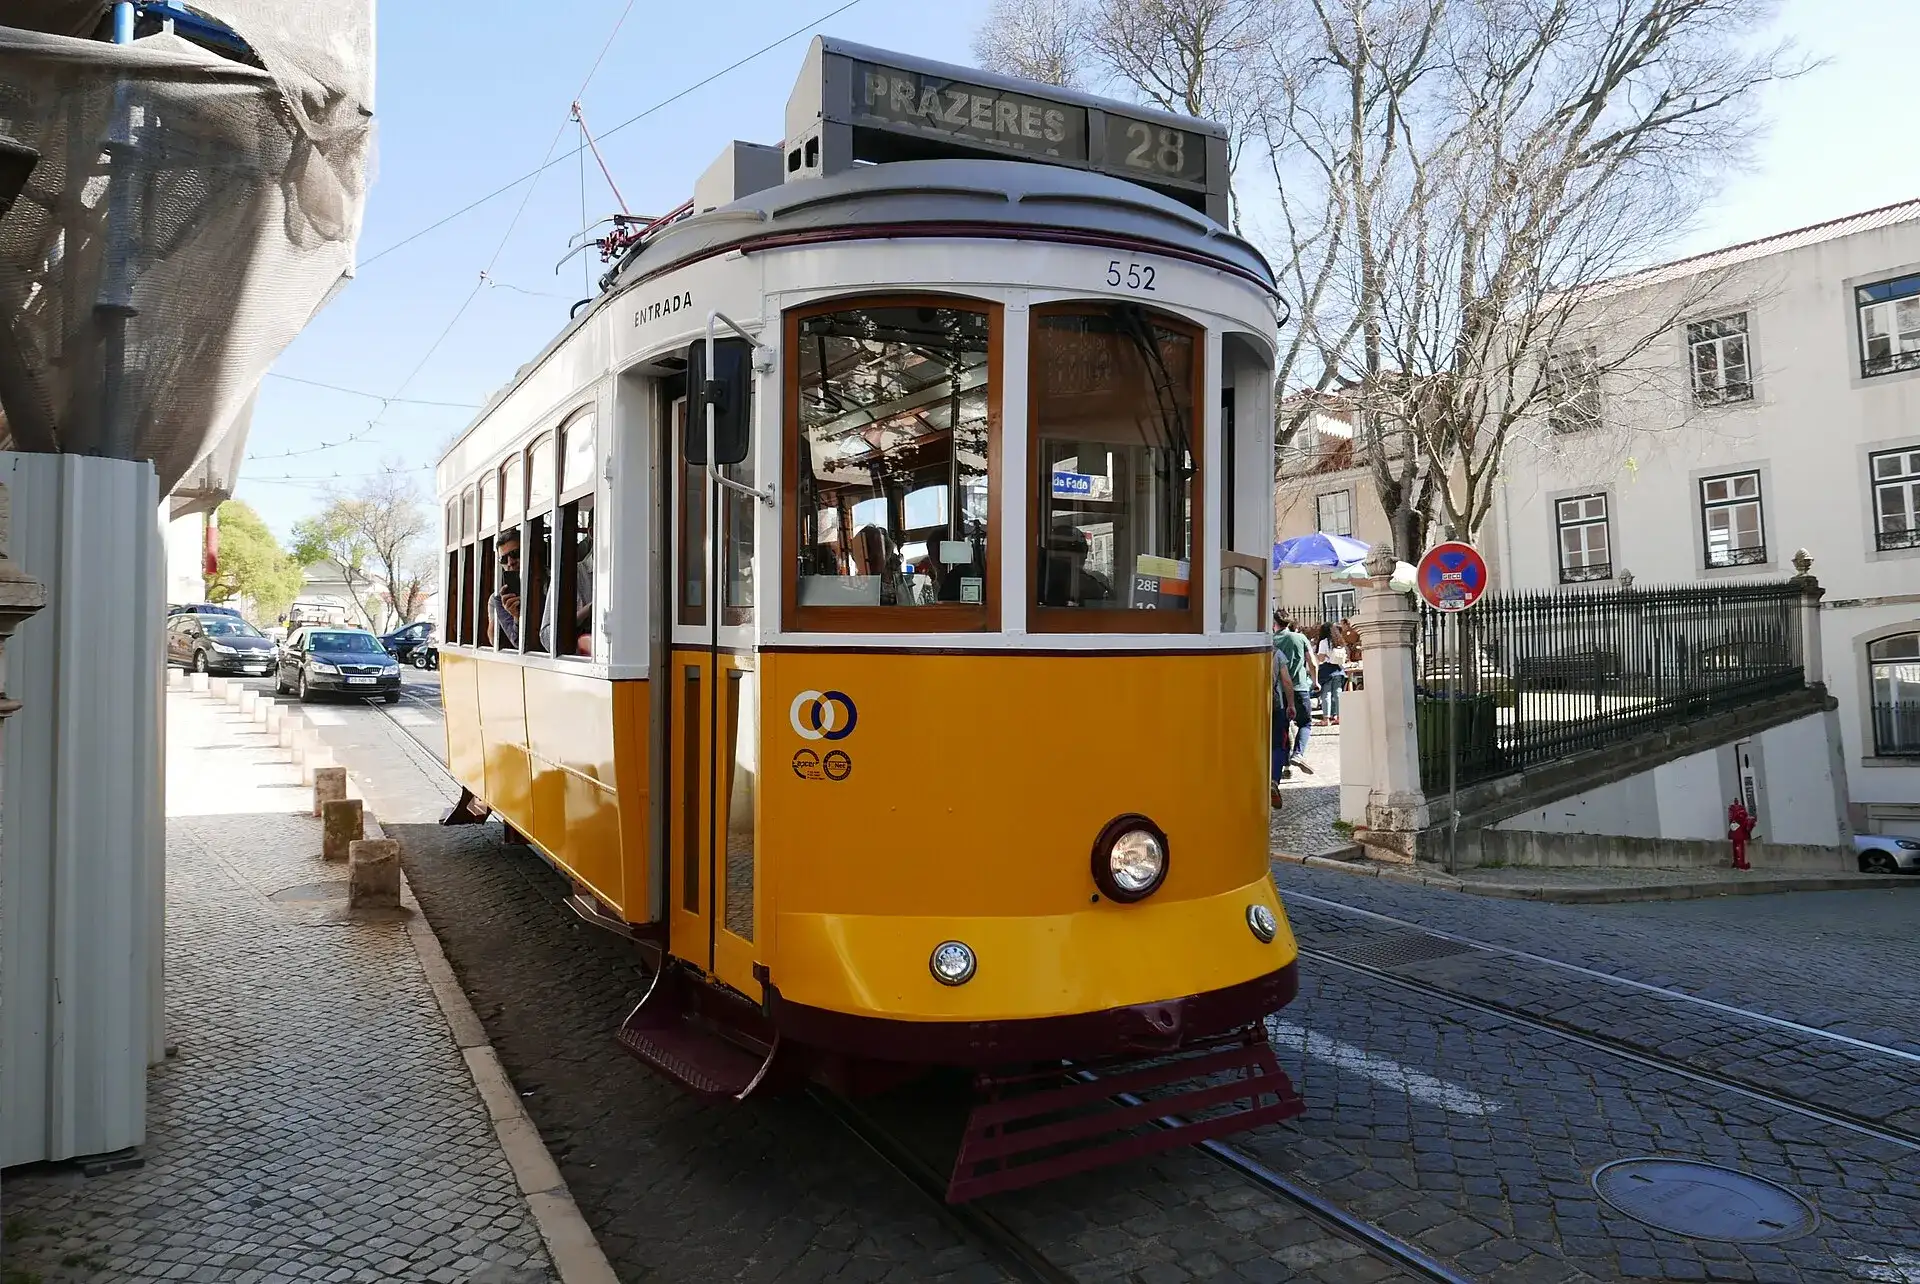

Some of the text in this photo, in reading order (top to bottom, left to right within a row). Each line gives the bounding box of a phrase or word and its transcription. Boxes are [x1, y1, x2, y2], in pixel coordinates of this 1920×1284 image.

[865, 72, 1185, 173] PRAZERES 28
[1106, 260, 1156, 291] 552
[634, 291, 692, 328] ENTRADA
[1066, 477, 1088, 490] Fado
[1137, 579, 1158, 592] 28E
